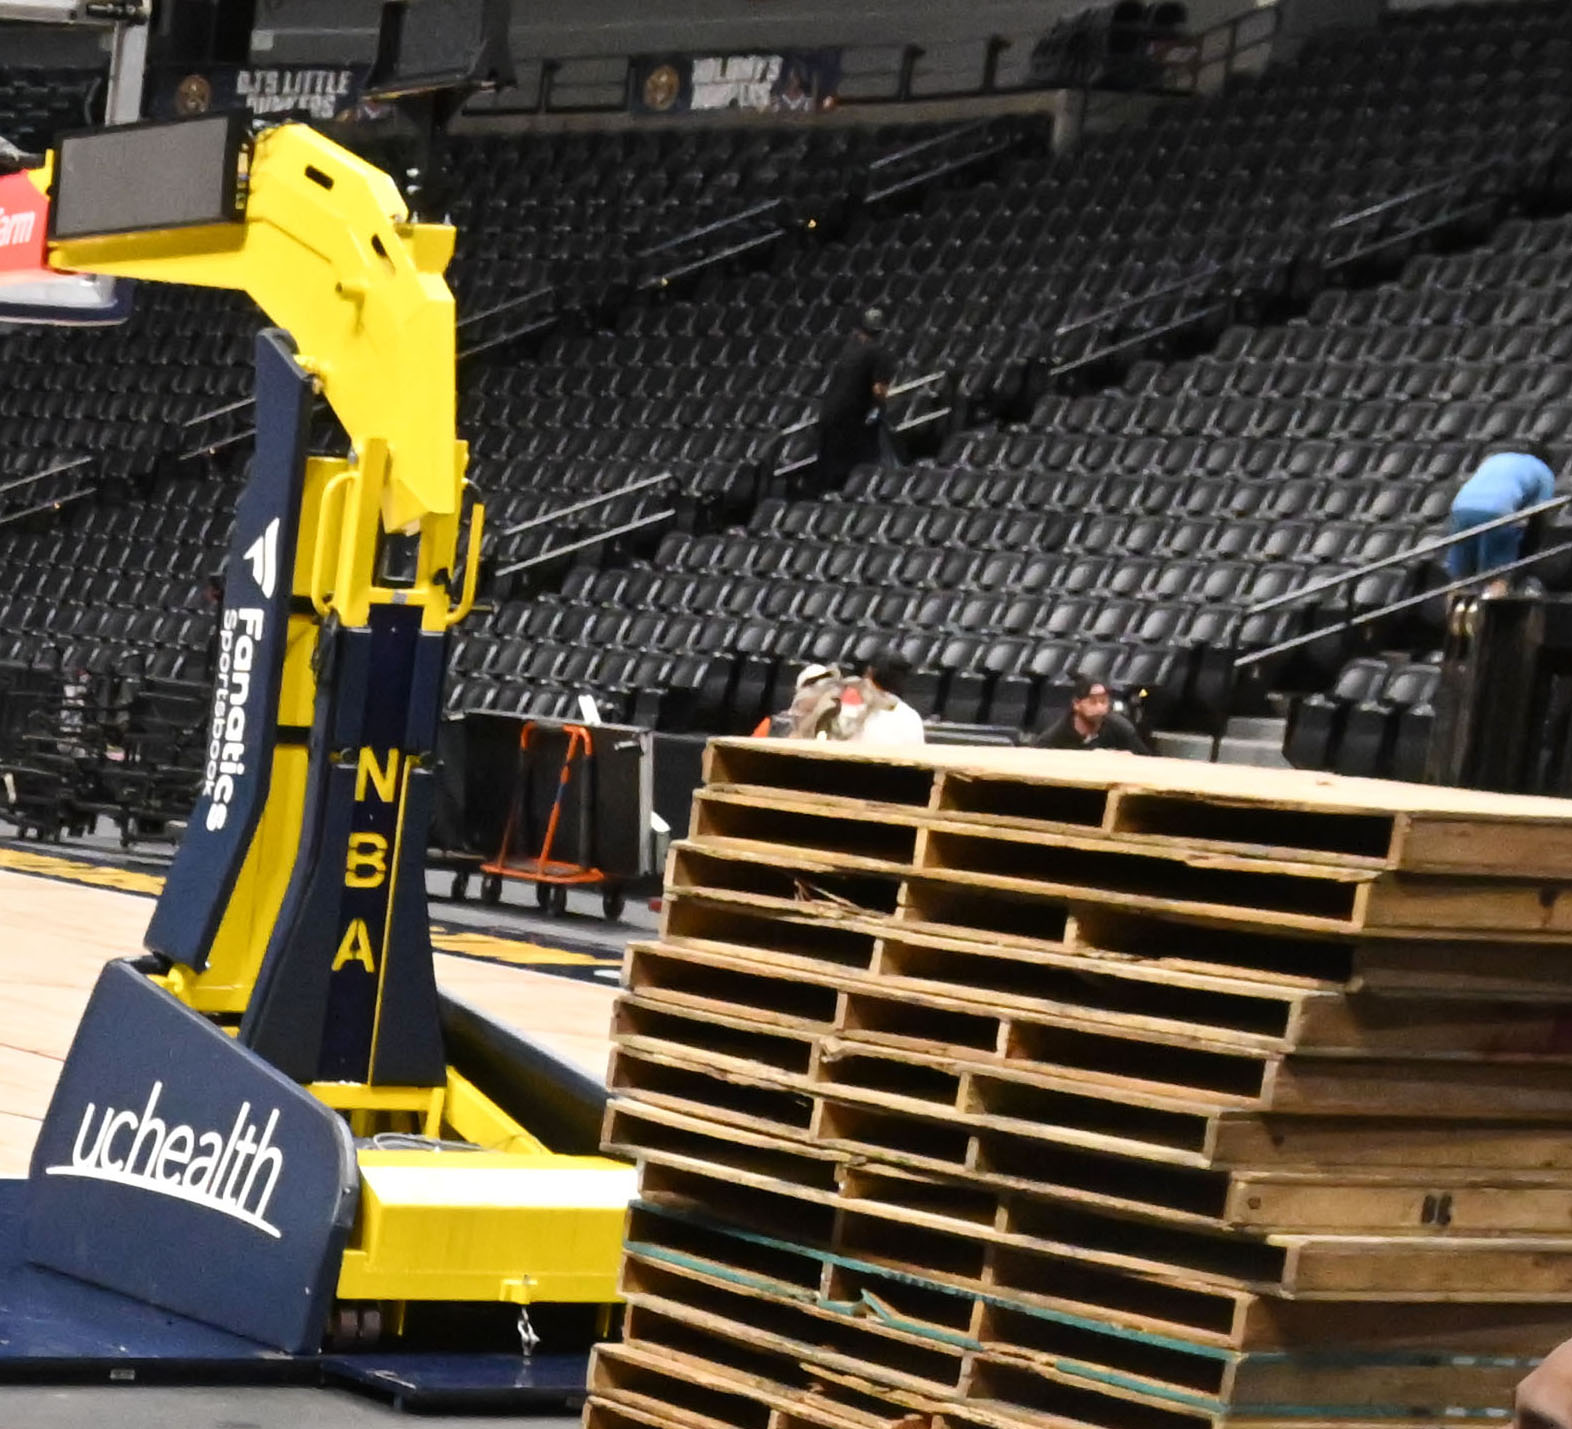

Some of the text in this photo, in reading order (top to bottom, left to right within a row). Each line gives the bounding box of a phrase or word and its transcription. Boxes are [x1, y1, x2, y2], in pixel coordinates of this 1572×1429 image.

[200, 608, 238, 797] Sportsbook
[205, 606, 265, 833] Fanatics
[72, 1081, 283, 1224] uchealth
